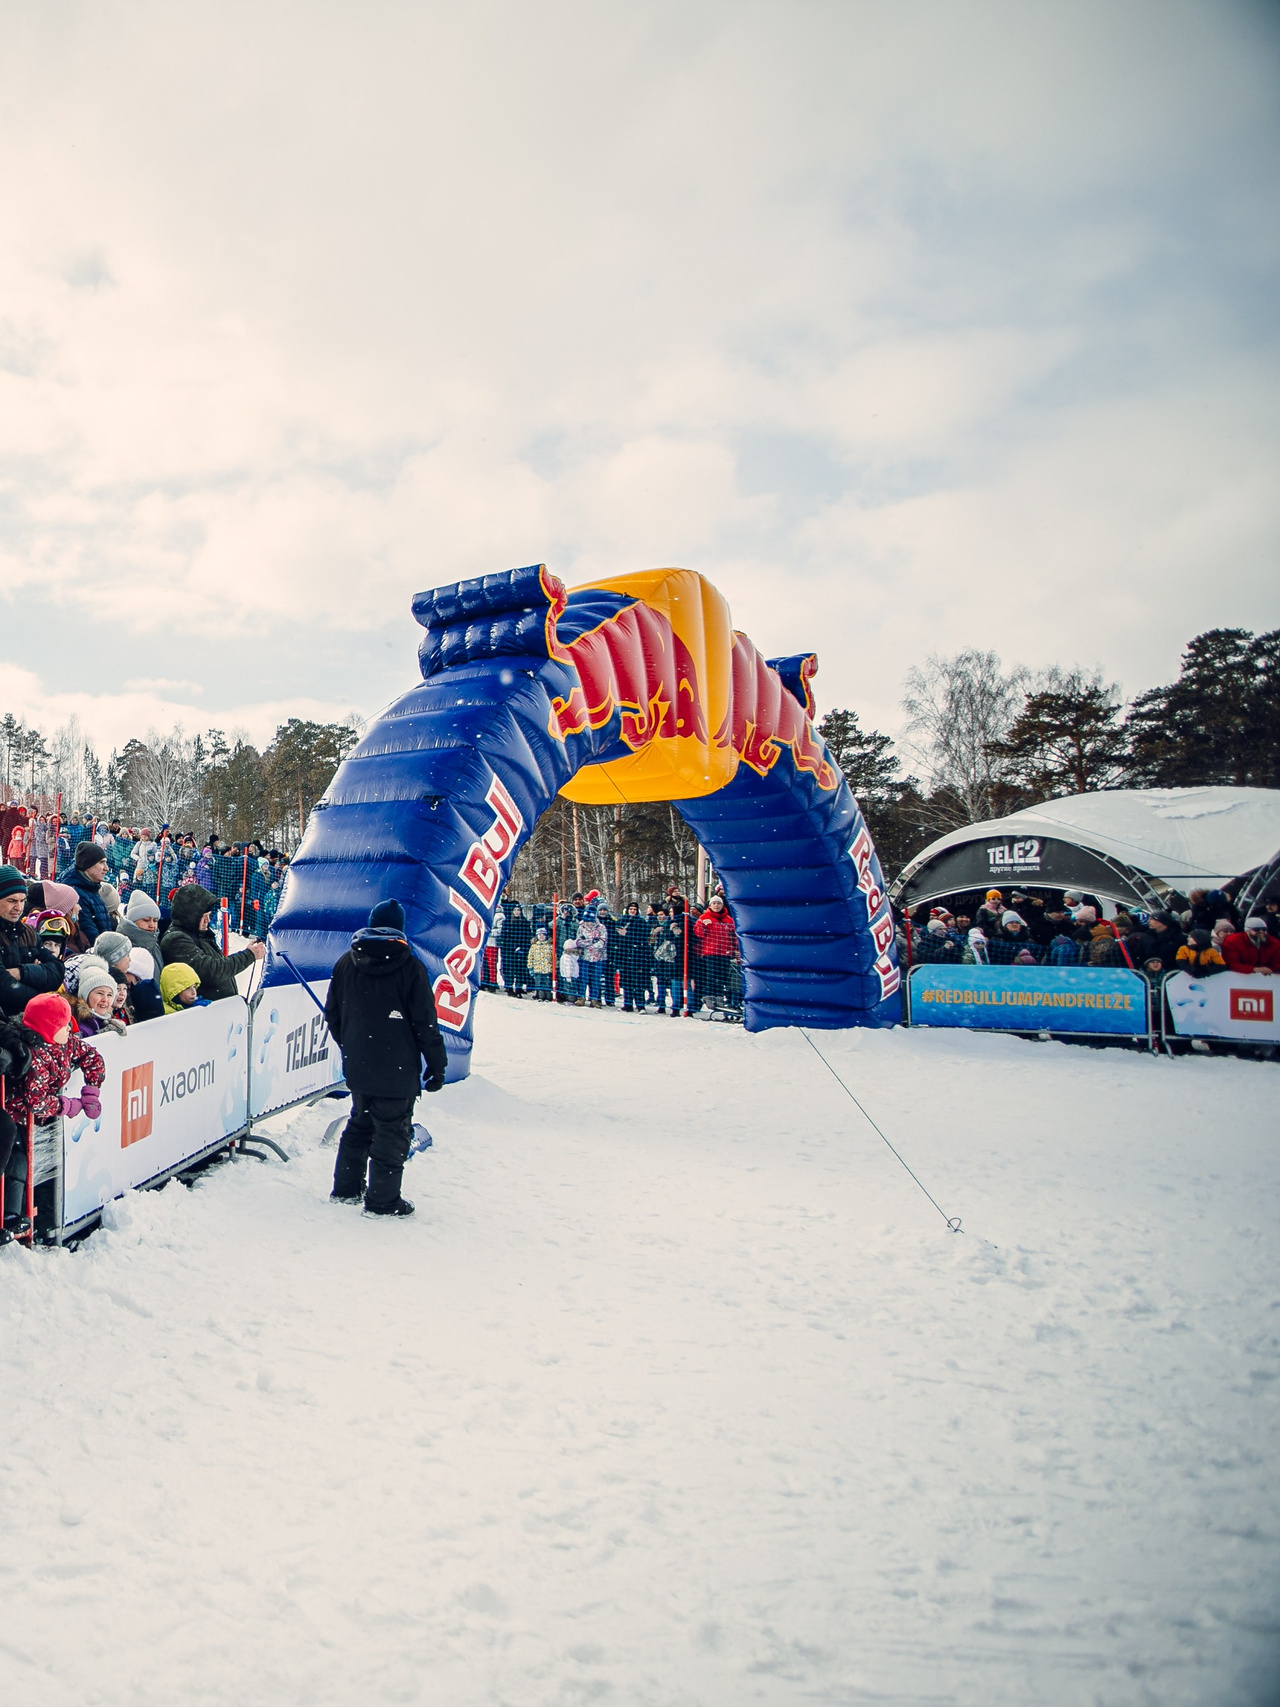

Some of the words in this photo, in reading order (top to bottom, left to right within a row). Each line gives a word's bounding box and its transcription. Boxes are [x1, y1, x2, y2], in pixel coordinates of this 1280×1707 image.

[987, 839, 1040, 865] TELE2
[432, 886, 485, 1032] Red
[459, 772, 523, 909] Bull
[848, 827, 886, 923] Red
[869, 912, 901, 1001] Bull
[954, 894, 986, 906] ДРУГИ
[921, 989, 1133, 1010] #REDBULLJUMPANDFREEZE
[159, 1059, 215, 1107] xiaomi
